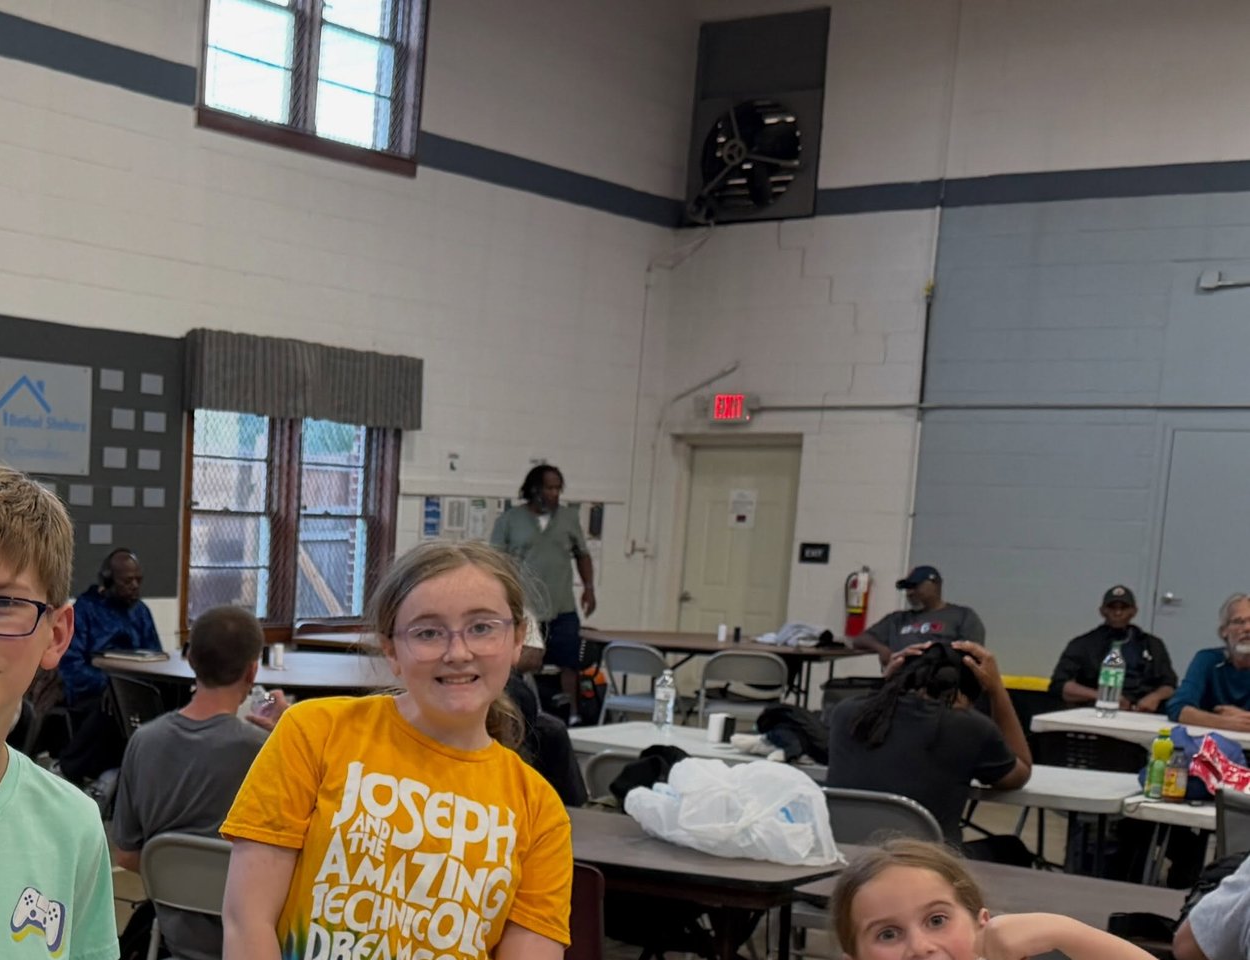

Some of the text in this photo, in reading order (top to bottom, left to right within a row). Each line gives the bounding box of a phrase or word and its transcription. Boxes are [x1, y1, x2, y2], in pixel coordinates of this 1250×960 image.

[714, 394, 744, 419] EXIT
[330, 761, 517, 870] JOSEPH
[350, 811, 391, 841] AND
[347, 830, 387, 862] THE
[314, 826, 512, 920] AMAZING
